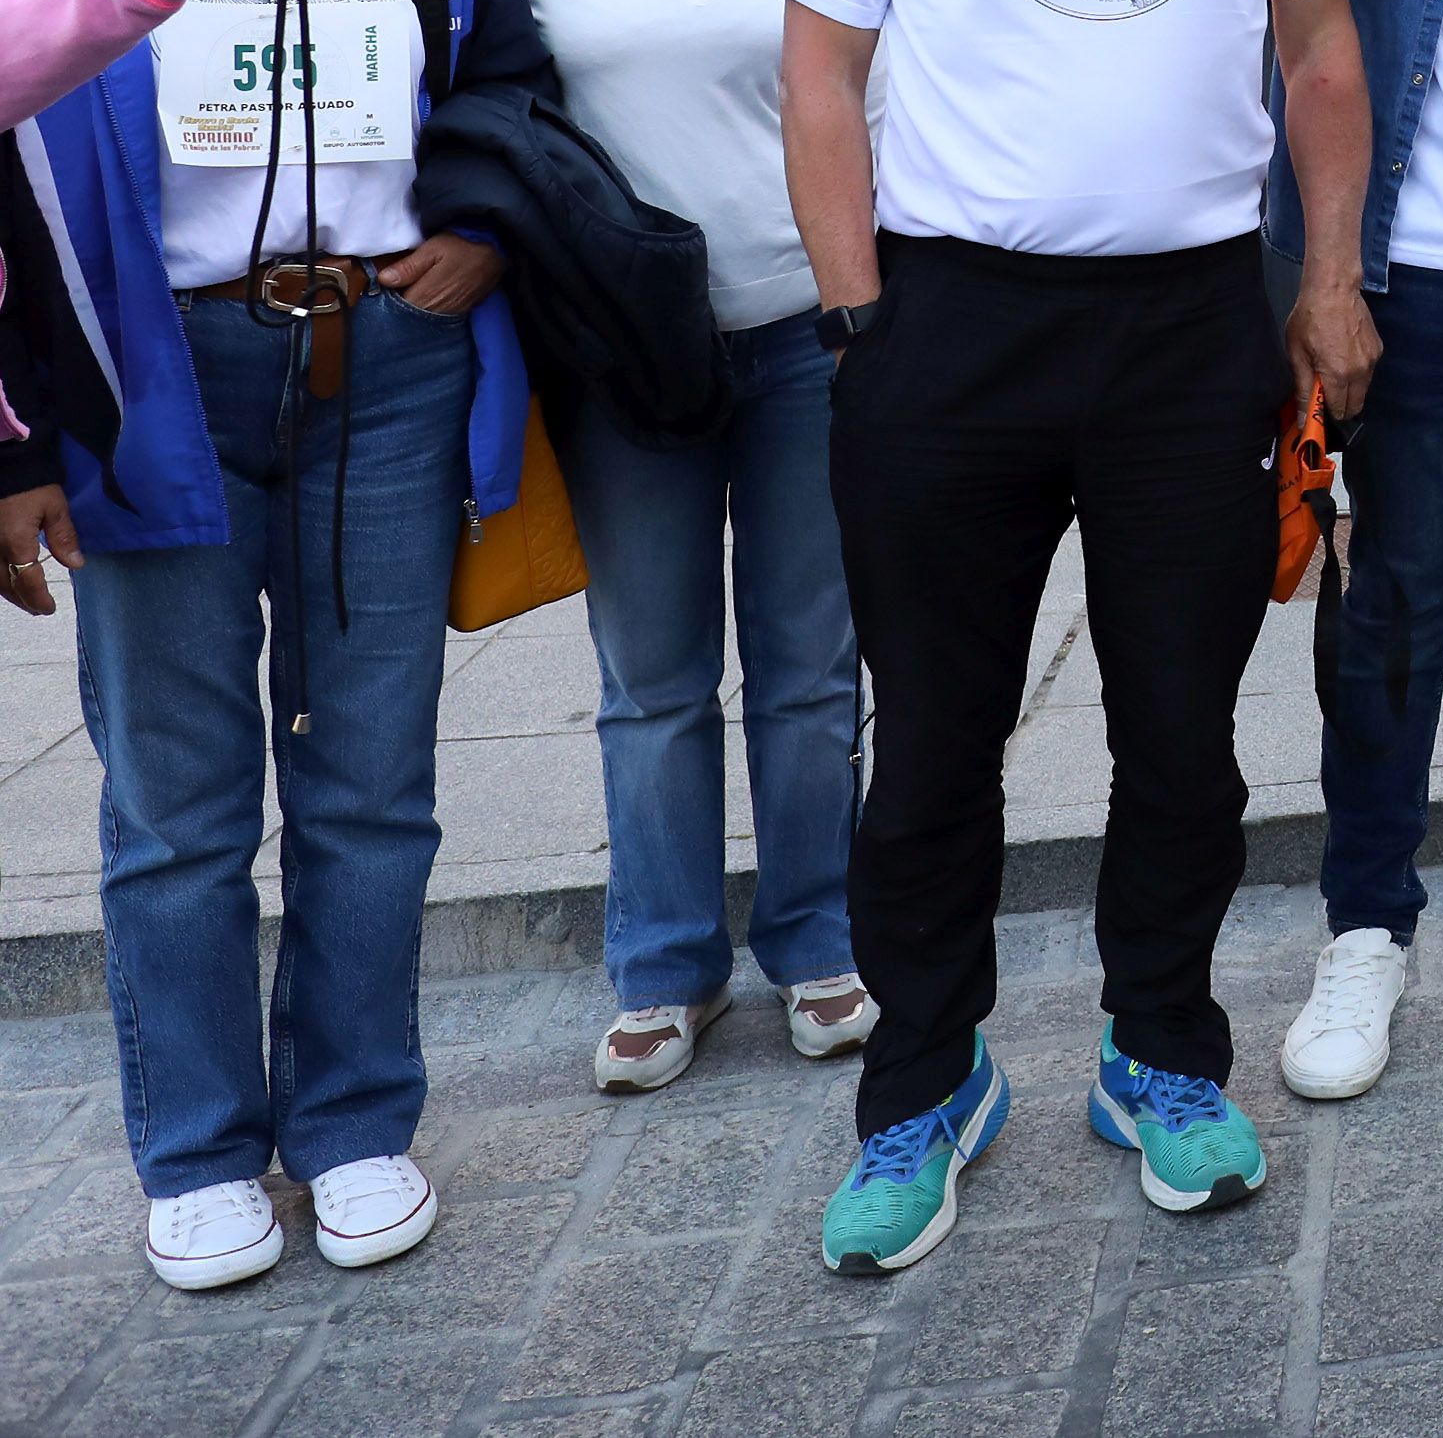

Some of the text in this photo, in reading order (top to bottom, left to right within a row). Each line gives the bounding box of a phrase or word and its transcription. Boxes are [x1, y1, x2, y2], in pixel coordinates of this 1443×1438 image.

[233, 44, 318, 92] 595
[365, 25, 378, 82] MARCHA
[199, 103, 237, 112] PETRA
[241, 102, 293, 112] PASTR
[183, 131, 253, 143] CIPRIANO
